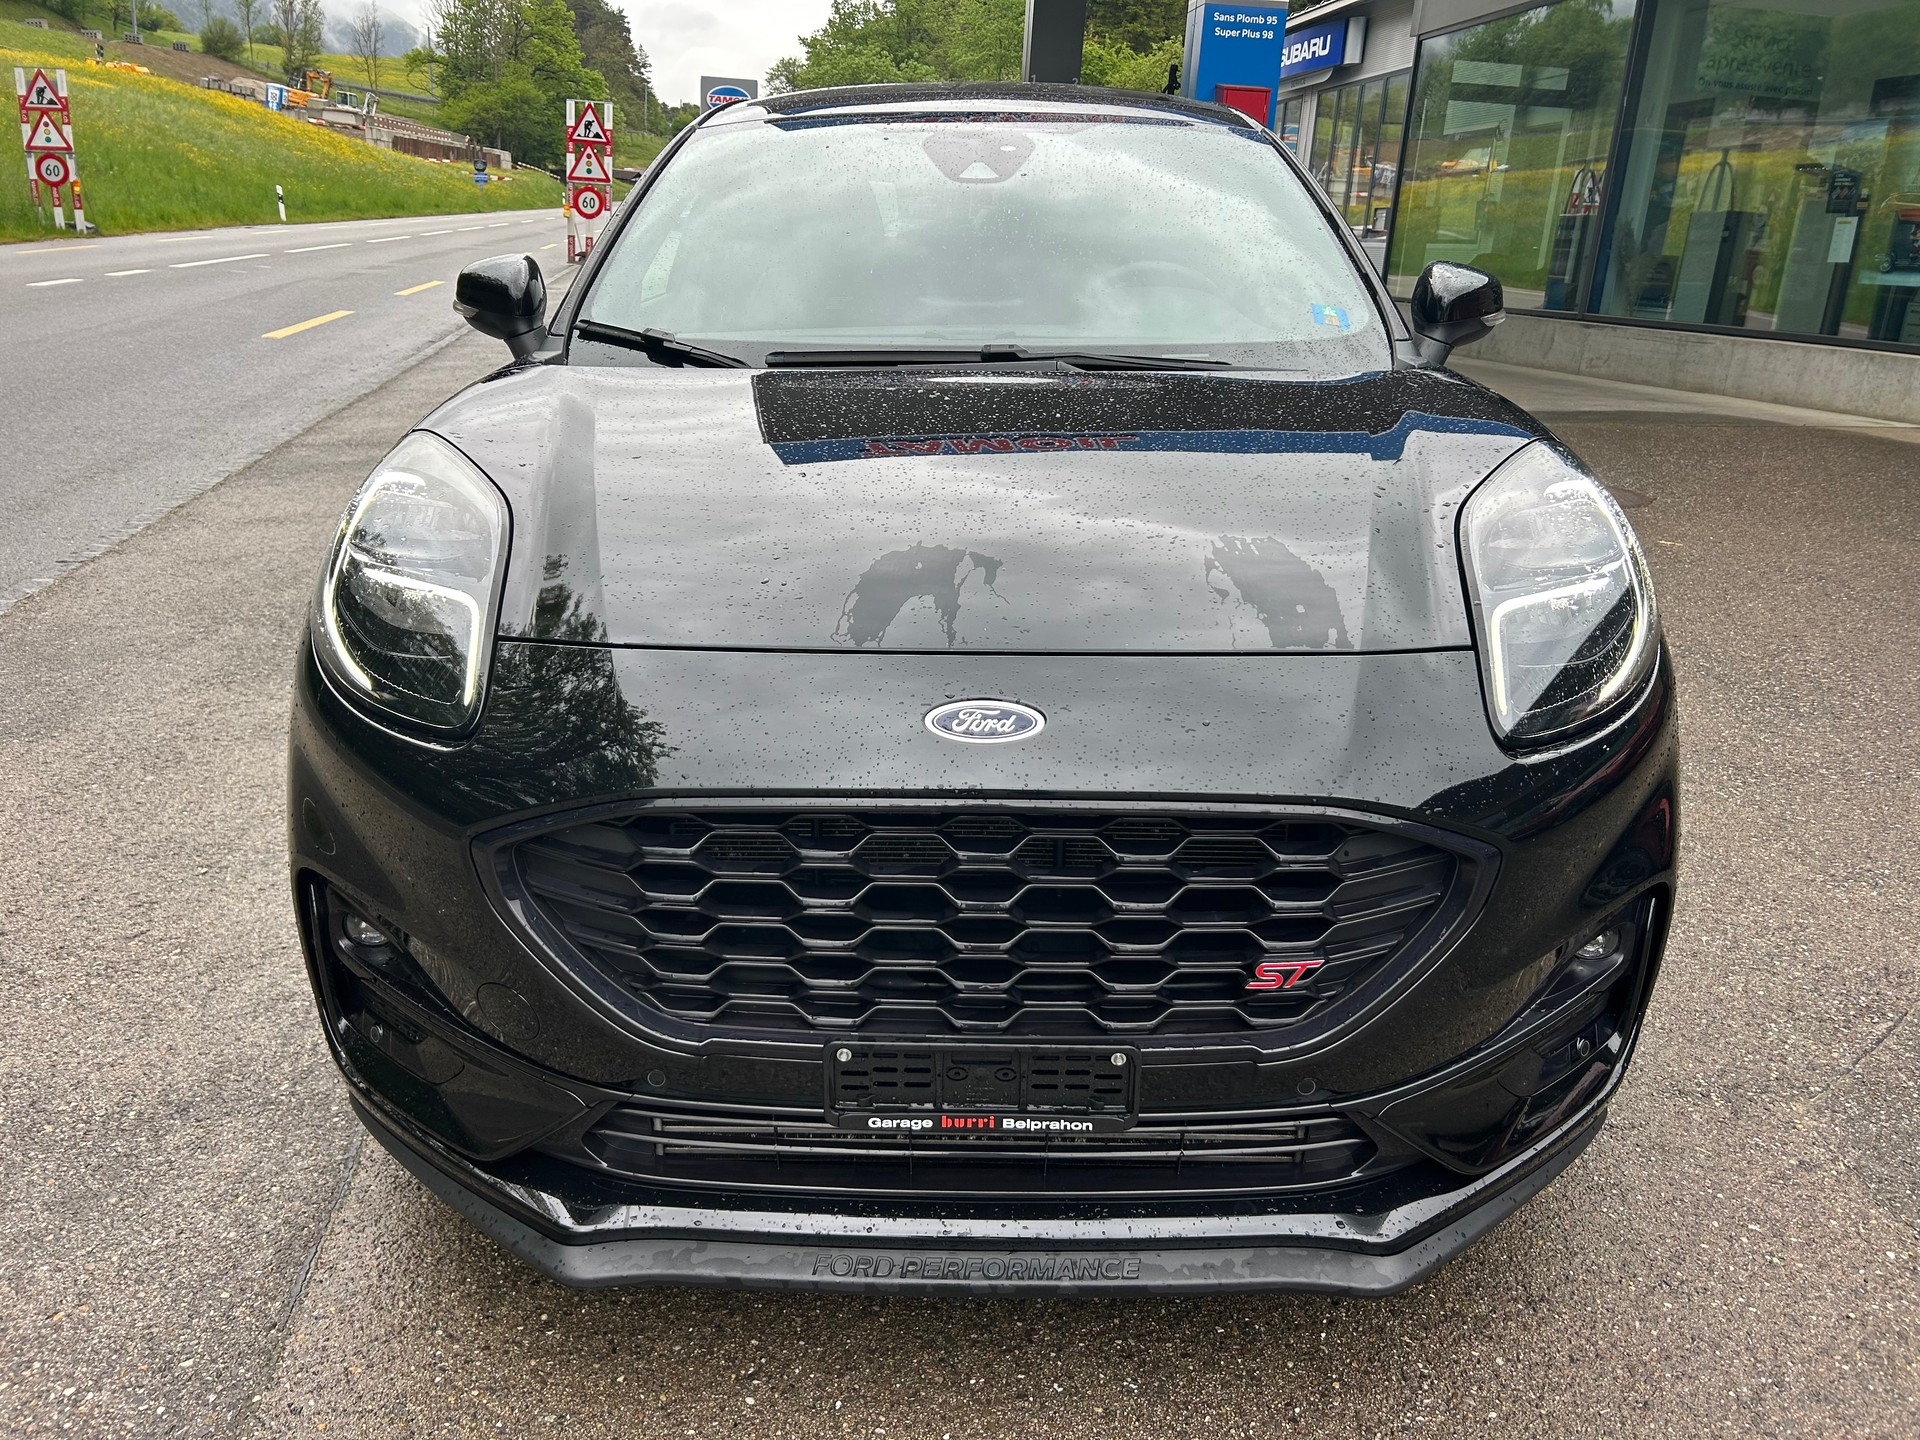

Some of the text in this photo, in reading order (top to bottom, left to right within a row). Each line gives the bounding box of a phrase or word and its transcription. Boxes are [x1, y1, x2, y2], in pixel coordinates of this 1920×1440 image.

[1213, 12, 1278, 25] Sans Plomb 95
[1214, 27, 1274, 39] Super Plus 98
[45, 164, 60, 177] 60
[582, 196, 596, 209] 60
[951, 708, 1017, 732] Ford
[1244, 960, 1325, 989] ST
[868, 1115, 1093, 1131] Garage burri Belprahon
[811, 1254, 1142, 1280] FORD PERFORMANCE
